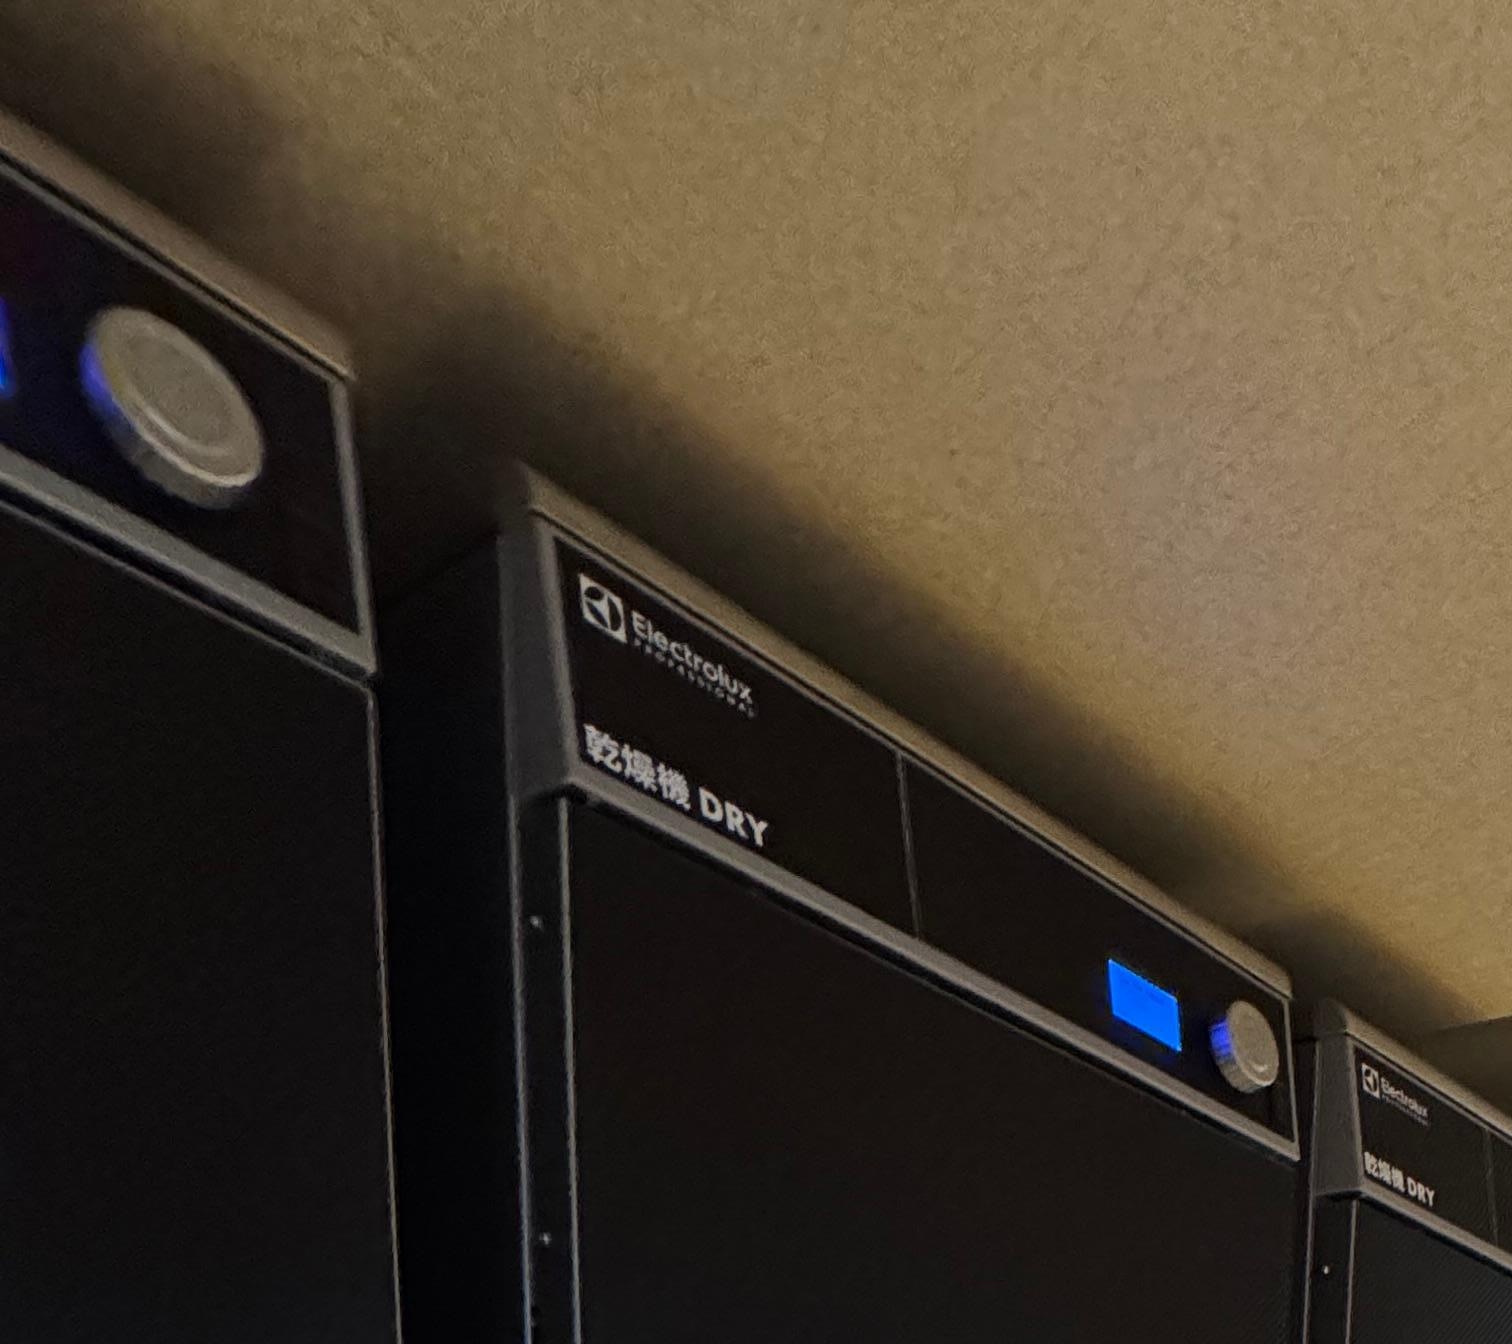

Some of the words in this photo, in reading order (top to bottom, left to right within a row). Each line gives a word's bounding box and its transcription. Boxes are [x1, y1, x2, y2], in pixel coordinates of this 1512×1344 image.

[631, 609, 753, 704] Electrolux
[699, 786, 769, 848] DRY
[1406, 1176, 1436, 1207] DRY
